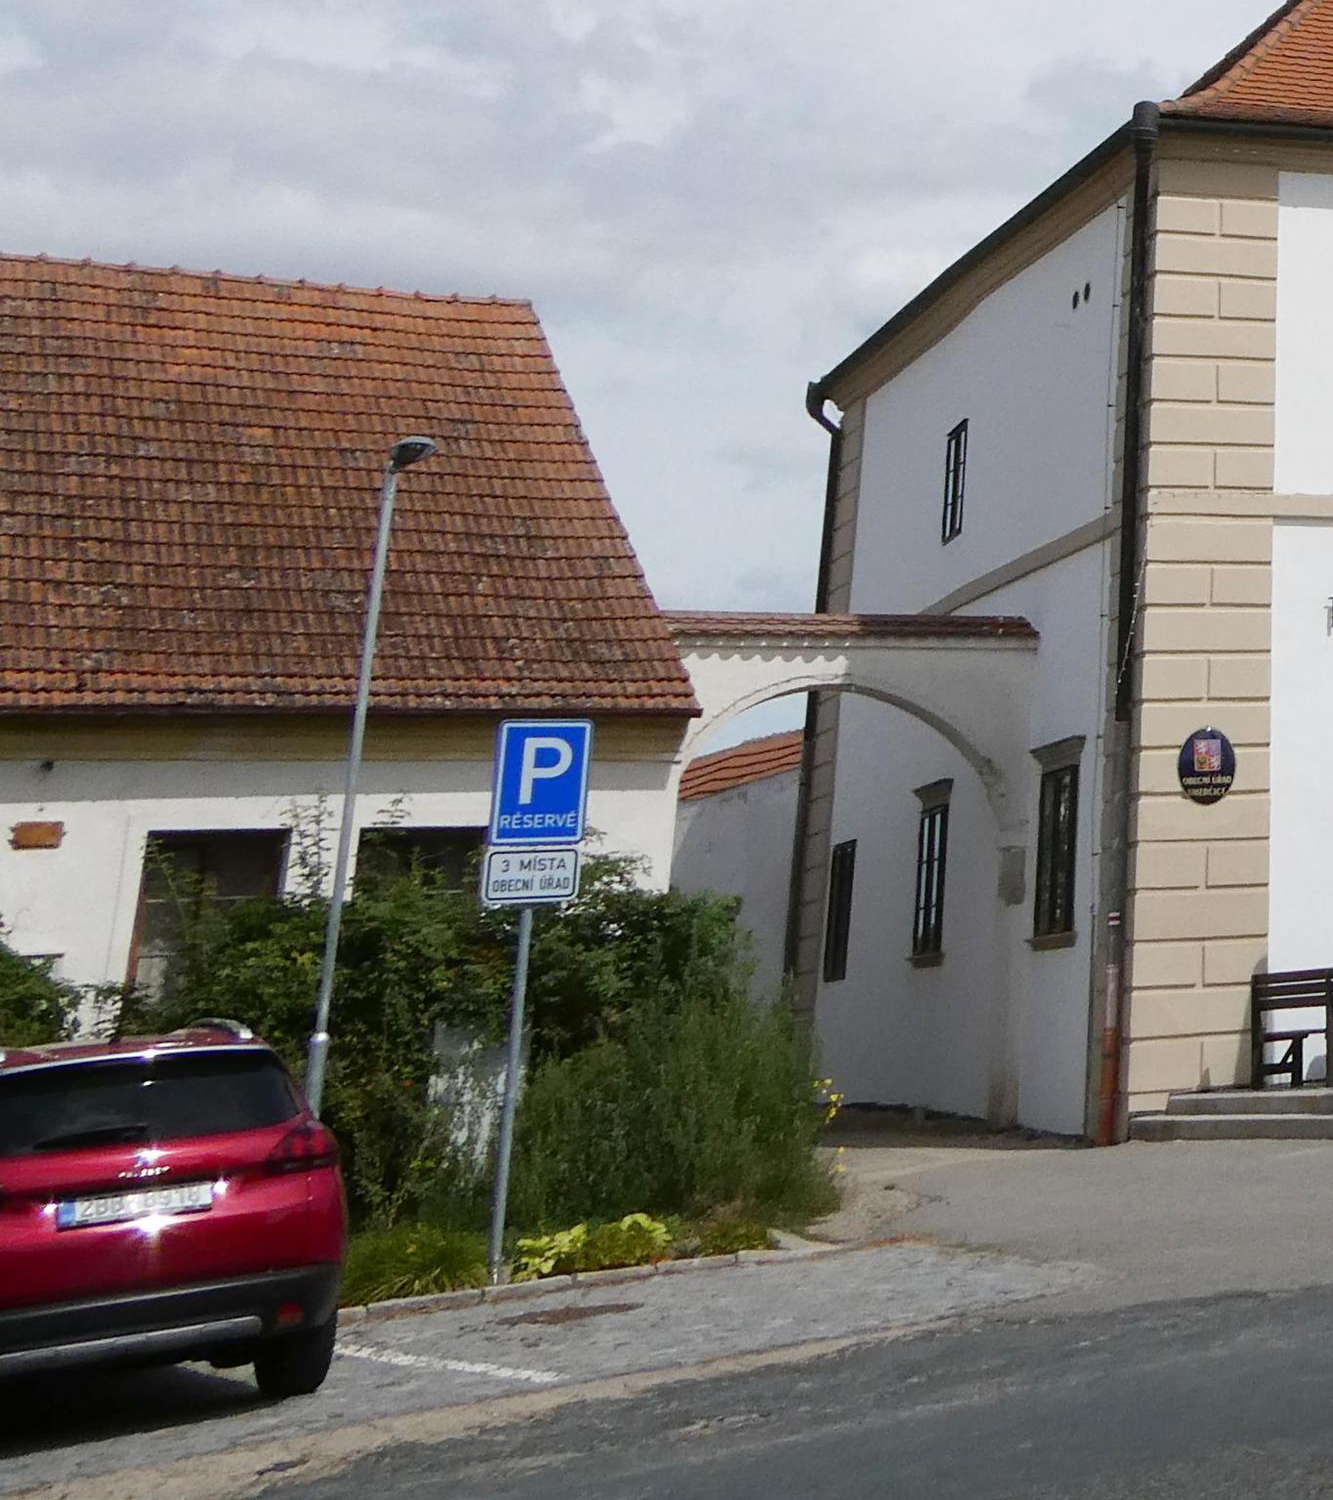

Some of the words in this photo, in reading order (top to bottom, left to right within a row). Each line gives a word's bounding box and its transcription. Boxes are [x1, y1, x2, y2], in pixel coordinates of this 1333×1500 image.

[518, 737, 573, 805] P
[500, 810, 577, 829] RÉSERVÉ
[501, 859, 510, 873] 3
[520, 855, 567, 872] MÍSTA
[492, 875, 535, 893] OBECNÍ
[539, 875, 571, 890] ÚŘAD
